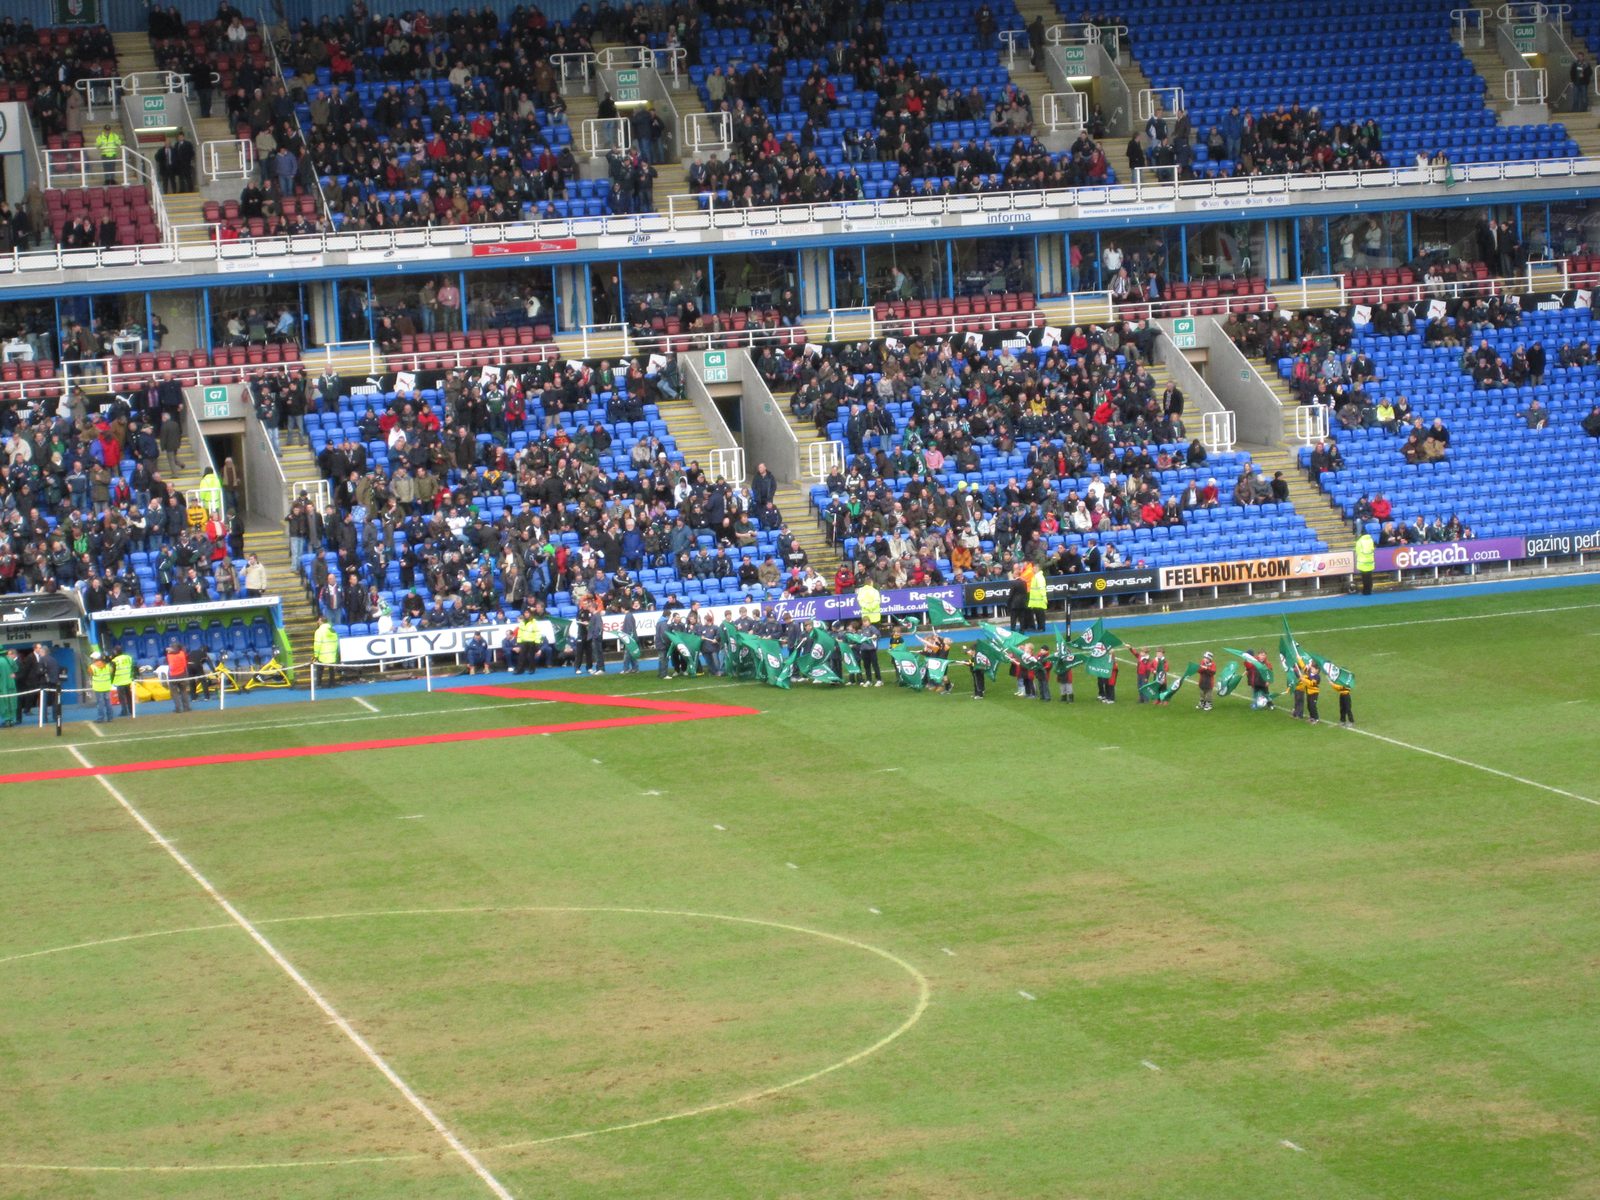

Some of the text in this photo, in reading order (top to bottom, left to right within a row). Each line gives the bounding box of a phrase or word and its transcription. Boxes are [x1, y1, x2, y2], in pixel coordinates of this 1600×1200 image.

[1066, 50, 1083, 58] GU9
[619, 74, 637, 82] GU8
[145, 99, 163, 108] GU7
[987, 212, 1031, 223] informa
[749, 228, 767, 236] TFM
[1537, 301, 1560, 310] PUMA
[1178, 322, 1190, 330] G9
[709, 356, 721, 364] G8
[209, 391, 222, 399] G7
[1527, 534, 1570, 557] gazing
[1165, 559, 1290, 586] FEELFRUITY.COM
[910, 590, 954, 601] Resort
[825, 597, 854, 609] Golf
[156, 615, 203, 625] Waitrose
[6, 623, 47, 633] London
[6, 631, 31, 641] Irish
[366, 628, 499, 656] CITYJET
